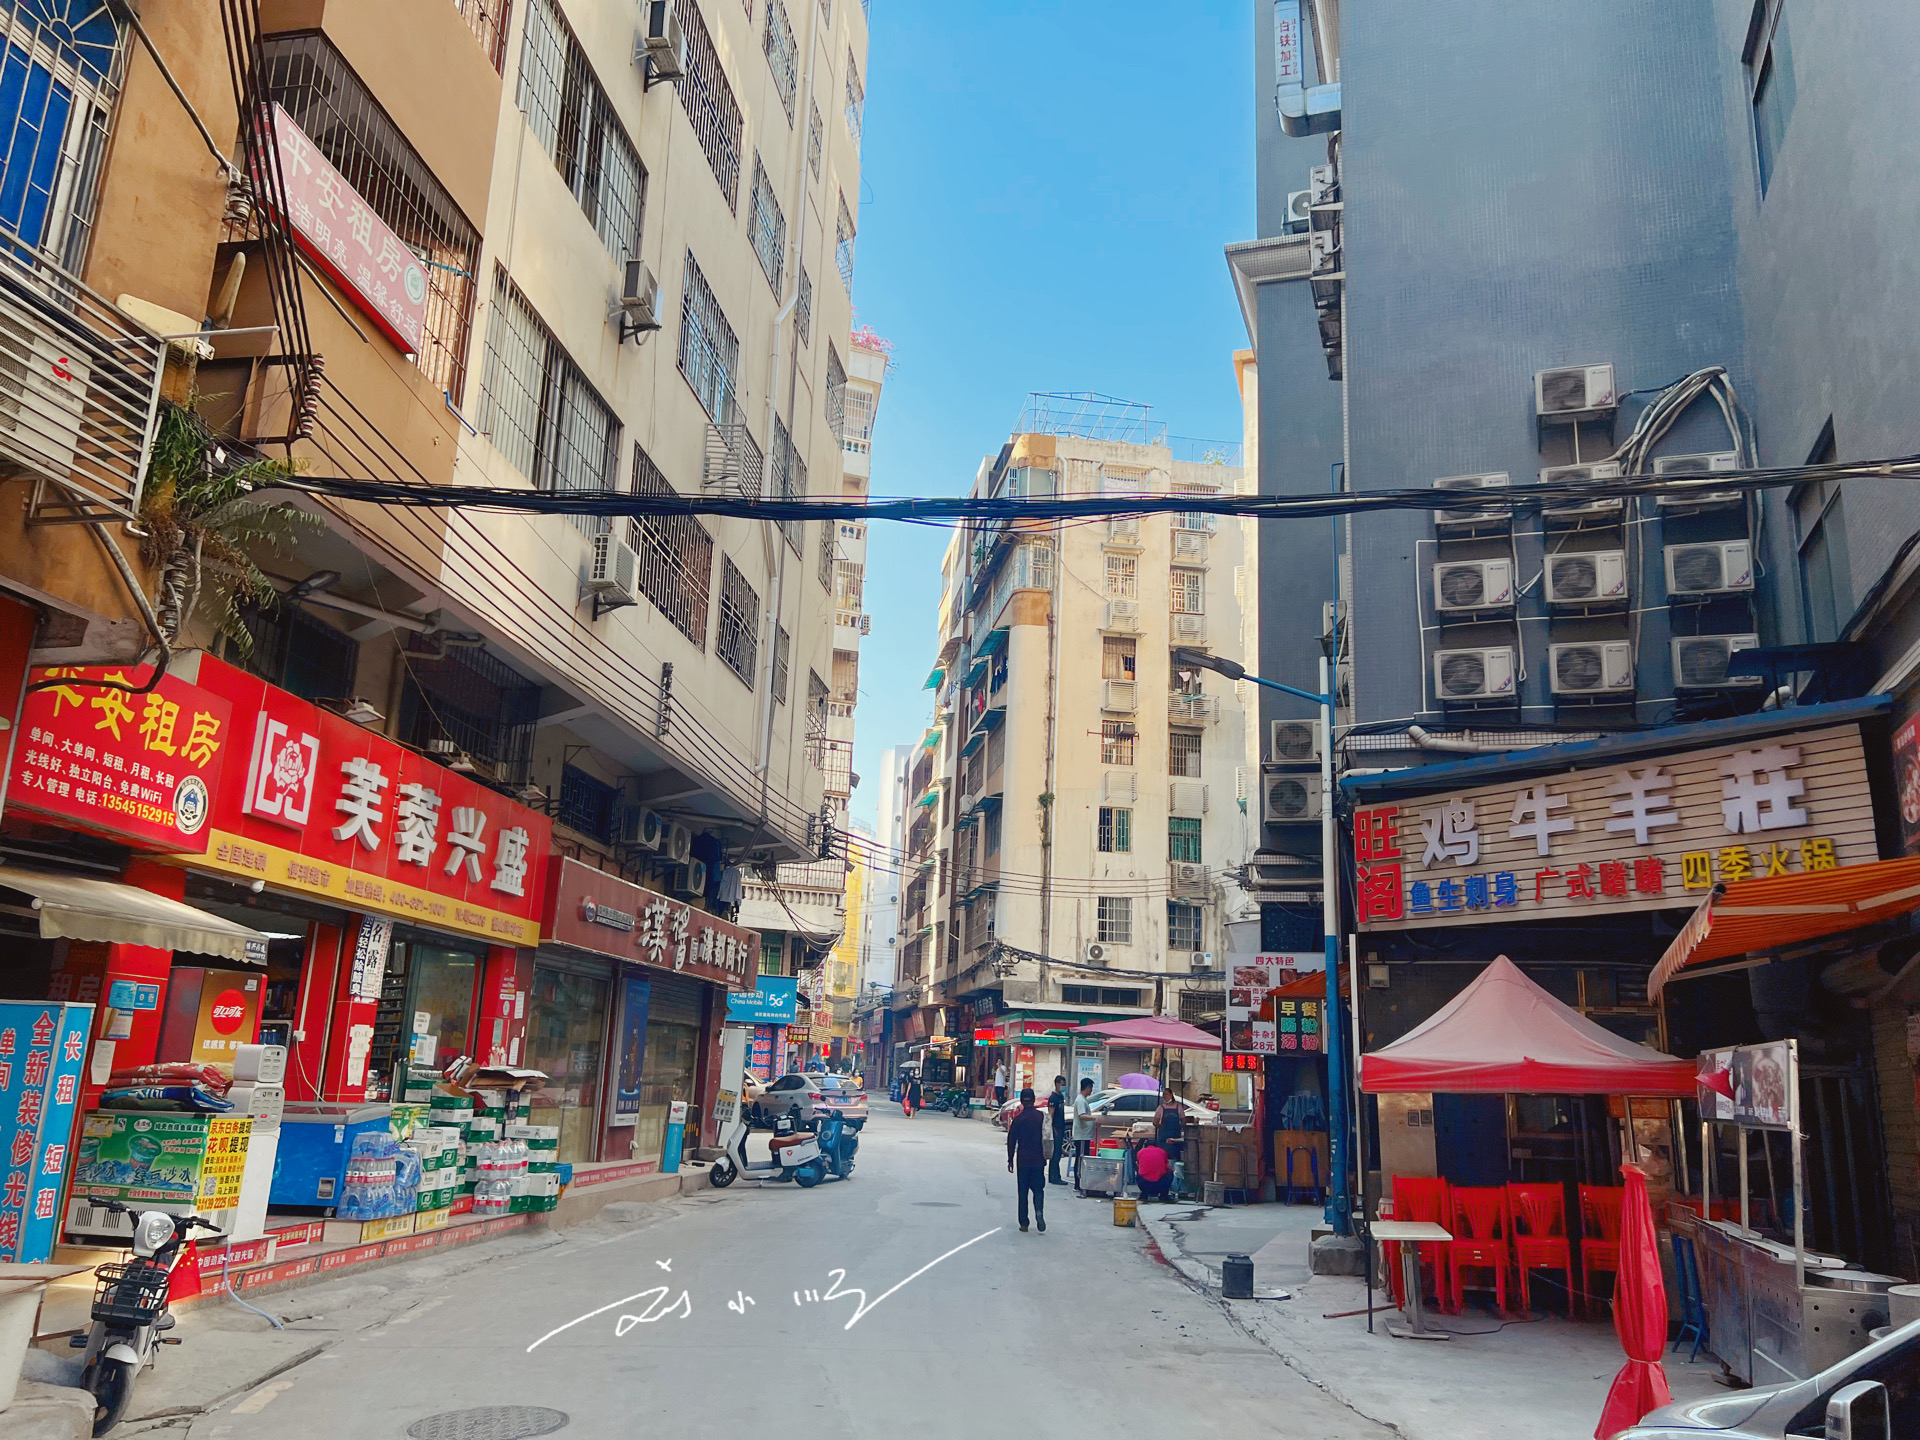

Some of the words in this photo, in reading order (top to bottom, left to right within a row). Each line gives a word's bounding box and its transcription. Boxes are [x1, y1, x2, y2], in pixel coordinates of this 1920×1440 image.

[1280, 20, 1291, 76] 白铁加工
[282, 126, 402, 283] 平安租房
[356, 263, 419, 342] 温馨舒适
[37, 667, 222, 769] 平安租房
[21, 770, 71, 798] 专人管理
[24, 750, 163, 804] 光线好、独立阳台、免费WiFi
[332, 757, 531, 897] 芙蓉兴盛
[216, 841, 268, 872] 全国连锁
[287, 859, 331, 888] 便利超市
[1354, 805, 1404, 922] 旺阁
[1410, 870, 1519, 914] 鱼生刺身
[1681, 837, 1838, 892] 四季火锅
[1255, 956, 1295, 966] 四大特色
[731, 997, 746, 1005] China
[746, 998, 763, 1006] Mobile
[1281, 1001, 1318, 1017] 早餐
[212, 1005, 245, 1018] 可口可乐
[755, 1026, 772, 1038] 专业
[1281, 1017, 1318, 1033] 肠粉
[754, 1039, 771, 1052] 维修
[1252, 1041, 1275, 1051] 28元
[1281, 1034, 1318, 1050] 汤粉
[56, 1030, 83, 1105] 长租
[753, 1053, 770, 1066] 电脑
[0, 1010, 54, 1263] 全新装修光线
[210, 1121, 253, 1134] 京东白条提现
[207, 1136, 250, 1154] 花呗提现
[36, 1143, 66, 1220] 短租
[135, 1166, 192, 1185] 绿豆沙冰
[228, 1248, 255, 1263] 欢迎光临
